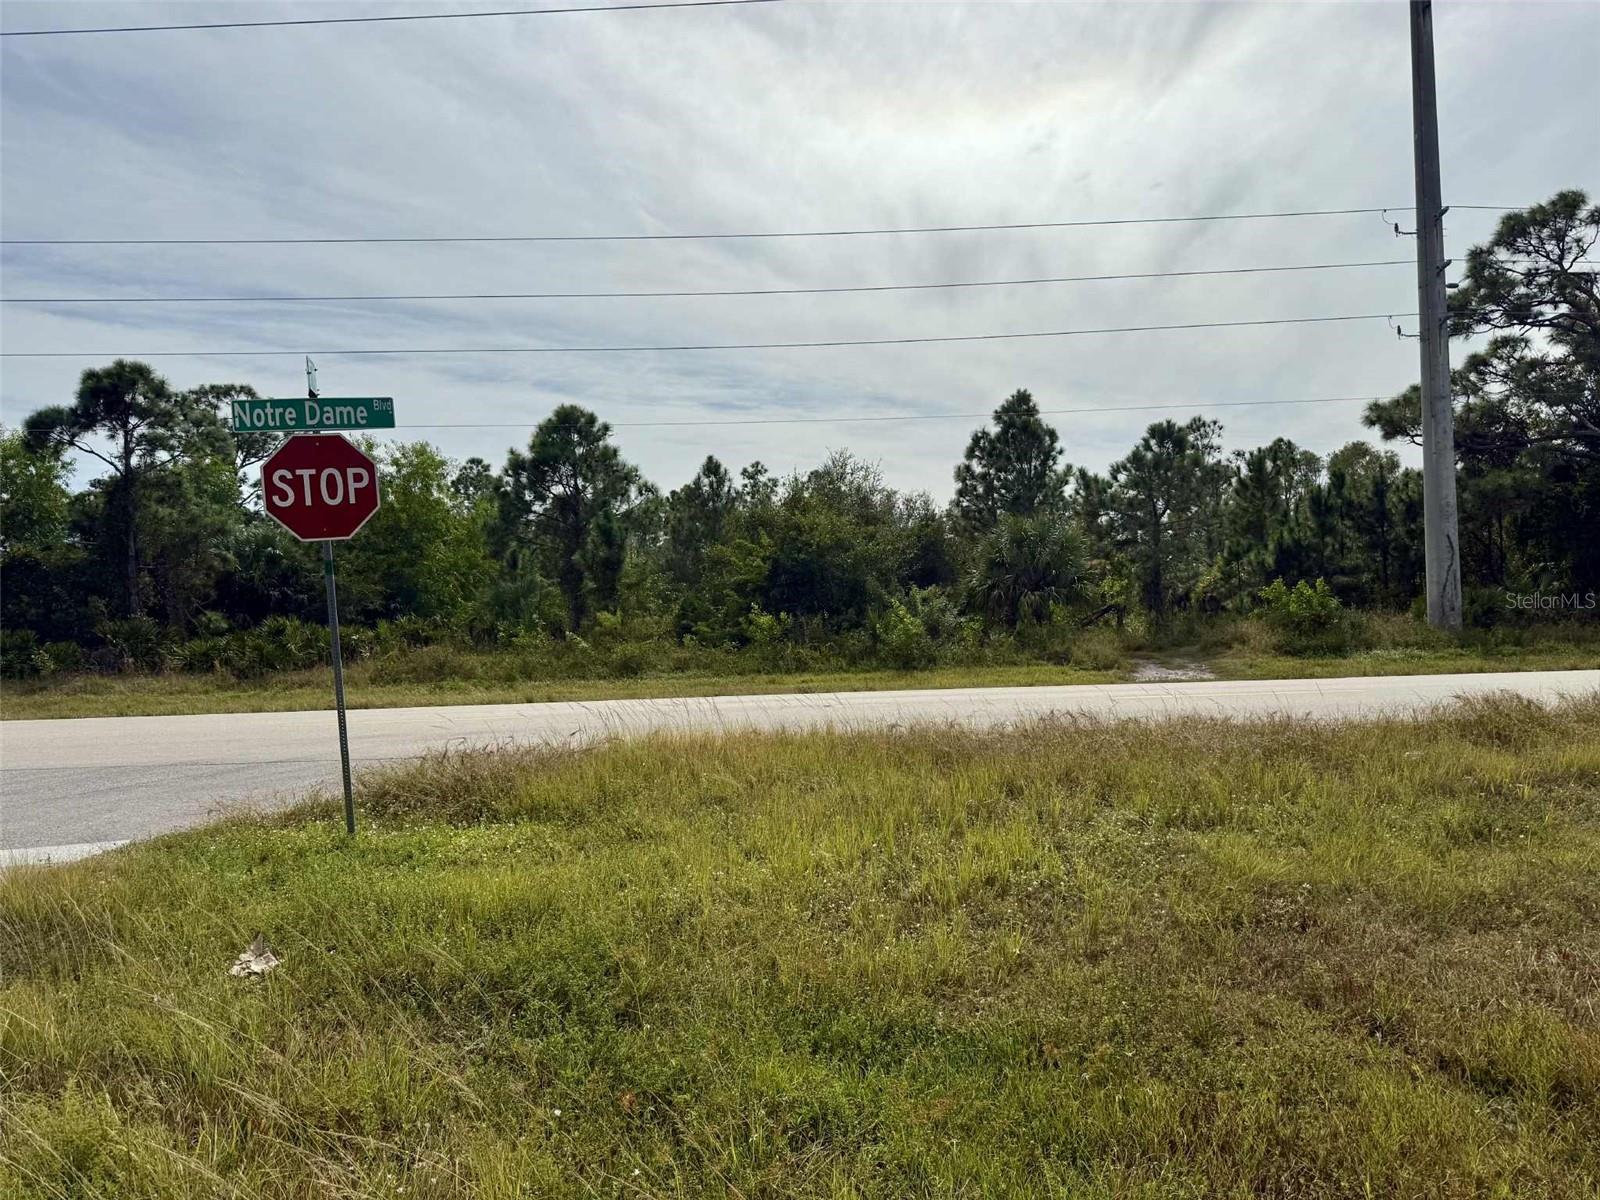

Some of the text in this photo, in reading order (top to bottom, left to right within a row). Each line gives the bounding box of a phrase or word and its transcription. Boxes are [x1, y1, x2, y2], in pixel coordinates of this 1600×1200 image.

[233, 399, 392, 428] Notre Dame Blvd
[271, 467, 369, 507] STOP
